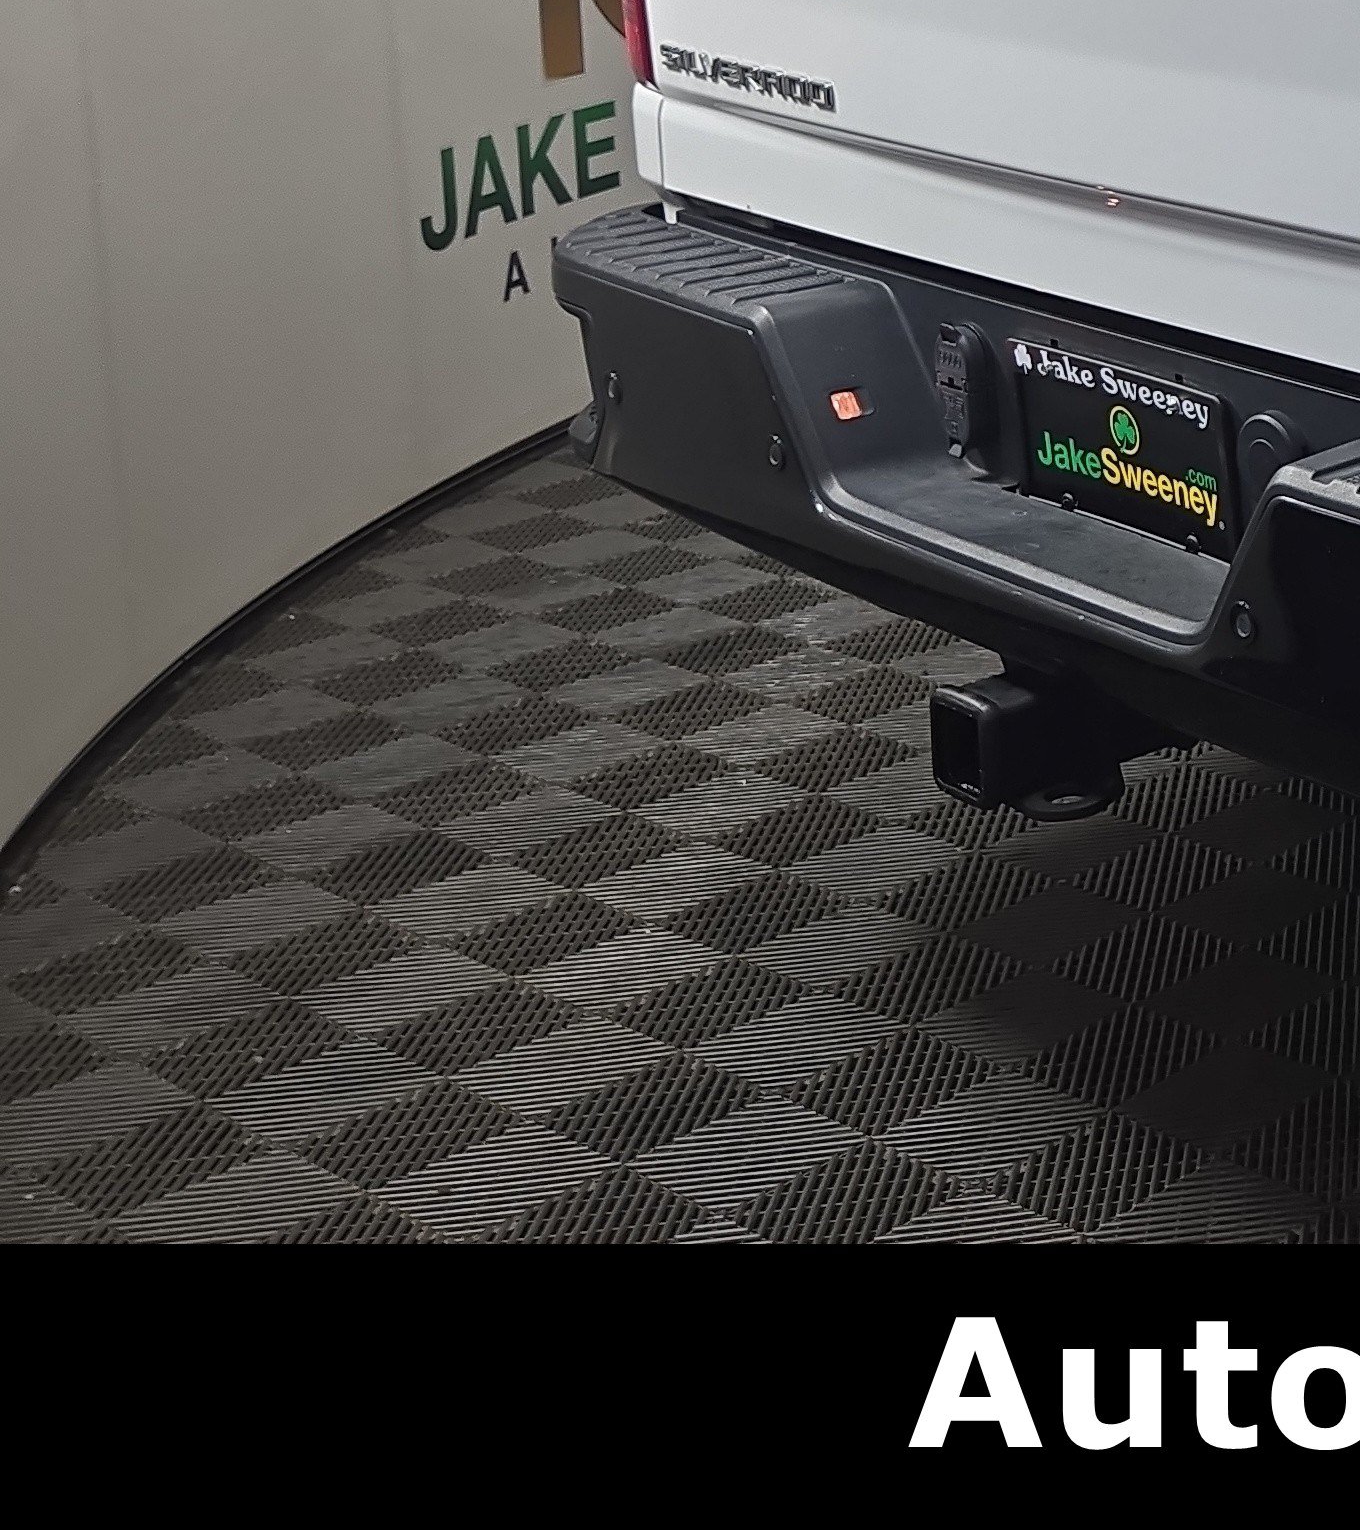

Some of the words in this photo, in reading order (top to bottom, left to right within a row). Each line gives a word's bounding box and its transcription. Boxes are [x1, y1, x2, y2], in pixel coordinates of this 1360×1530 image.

[659, 42, 838, 113] SILVERADO
[420, 101, 621, 252] JAKE
[1037, 349, 1096, 388] Jake
[1100, 366, 1209, 429] Sweeney
